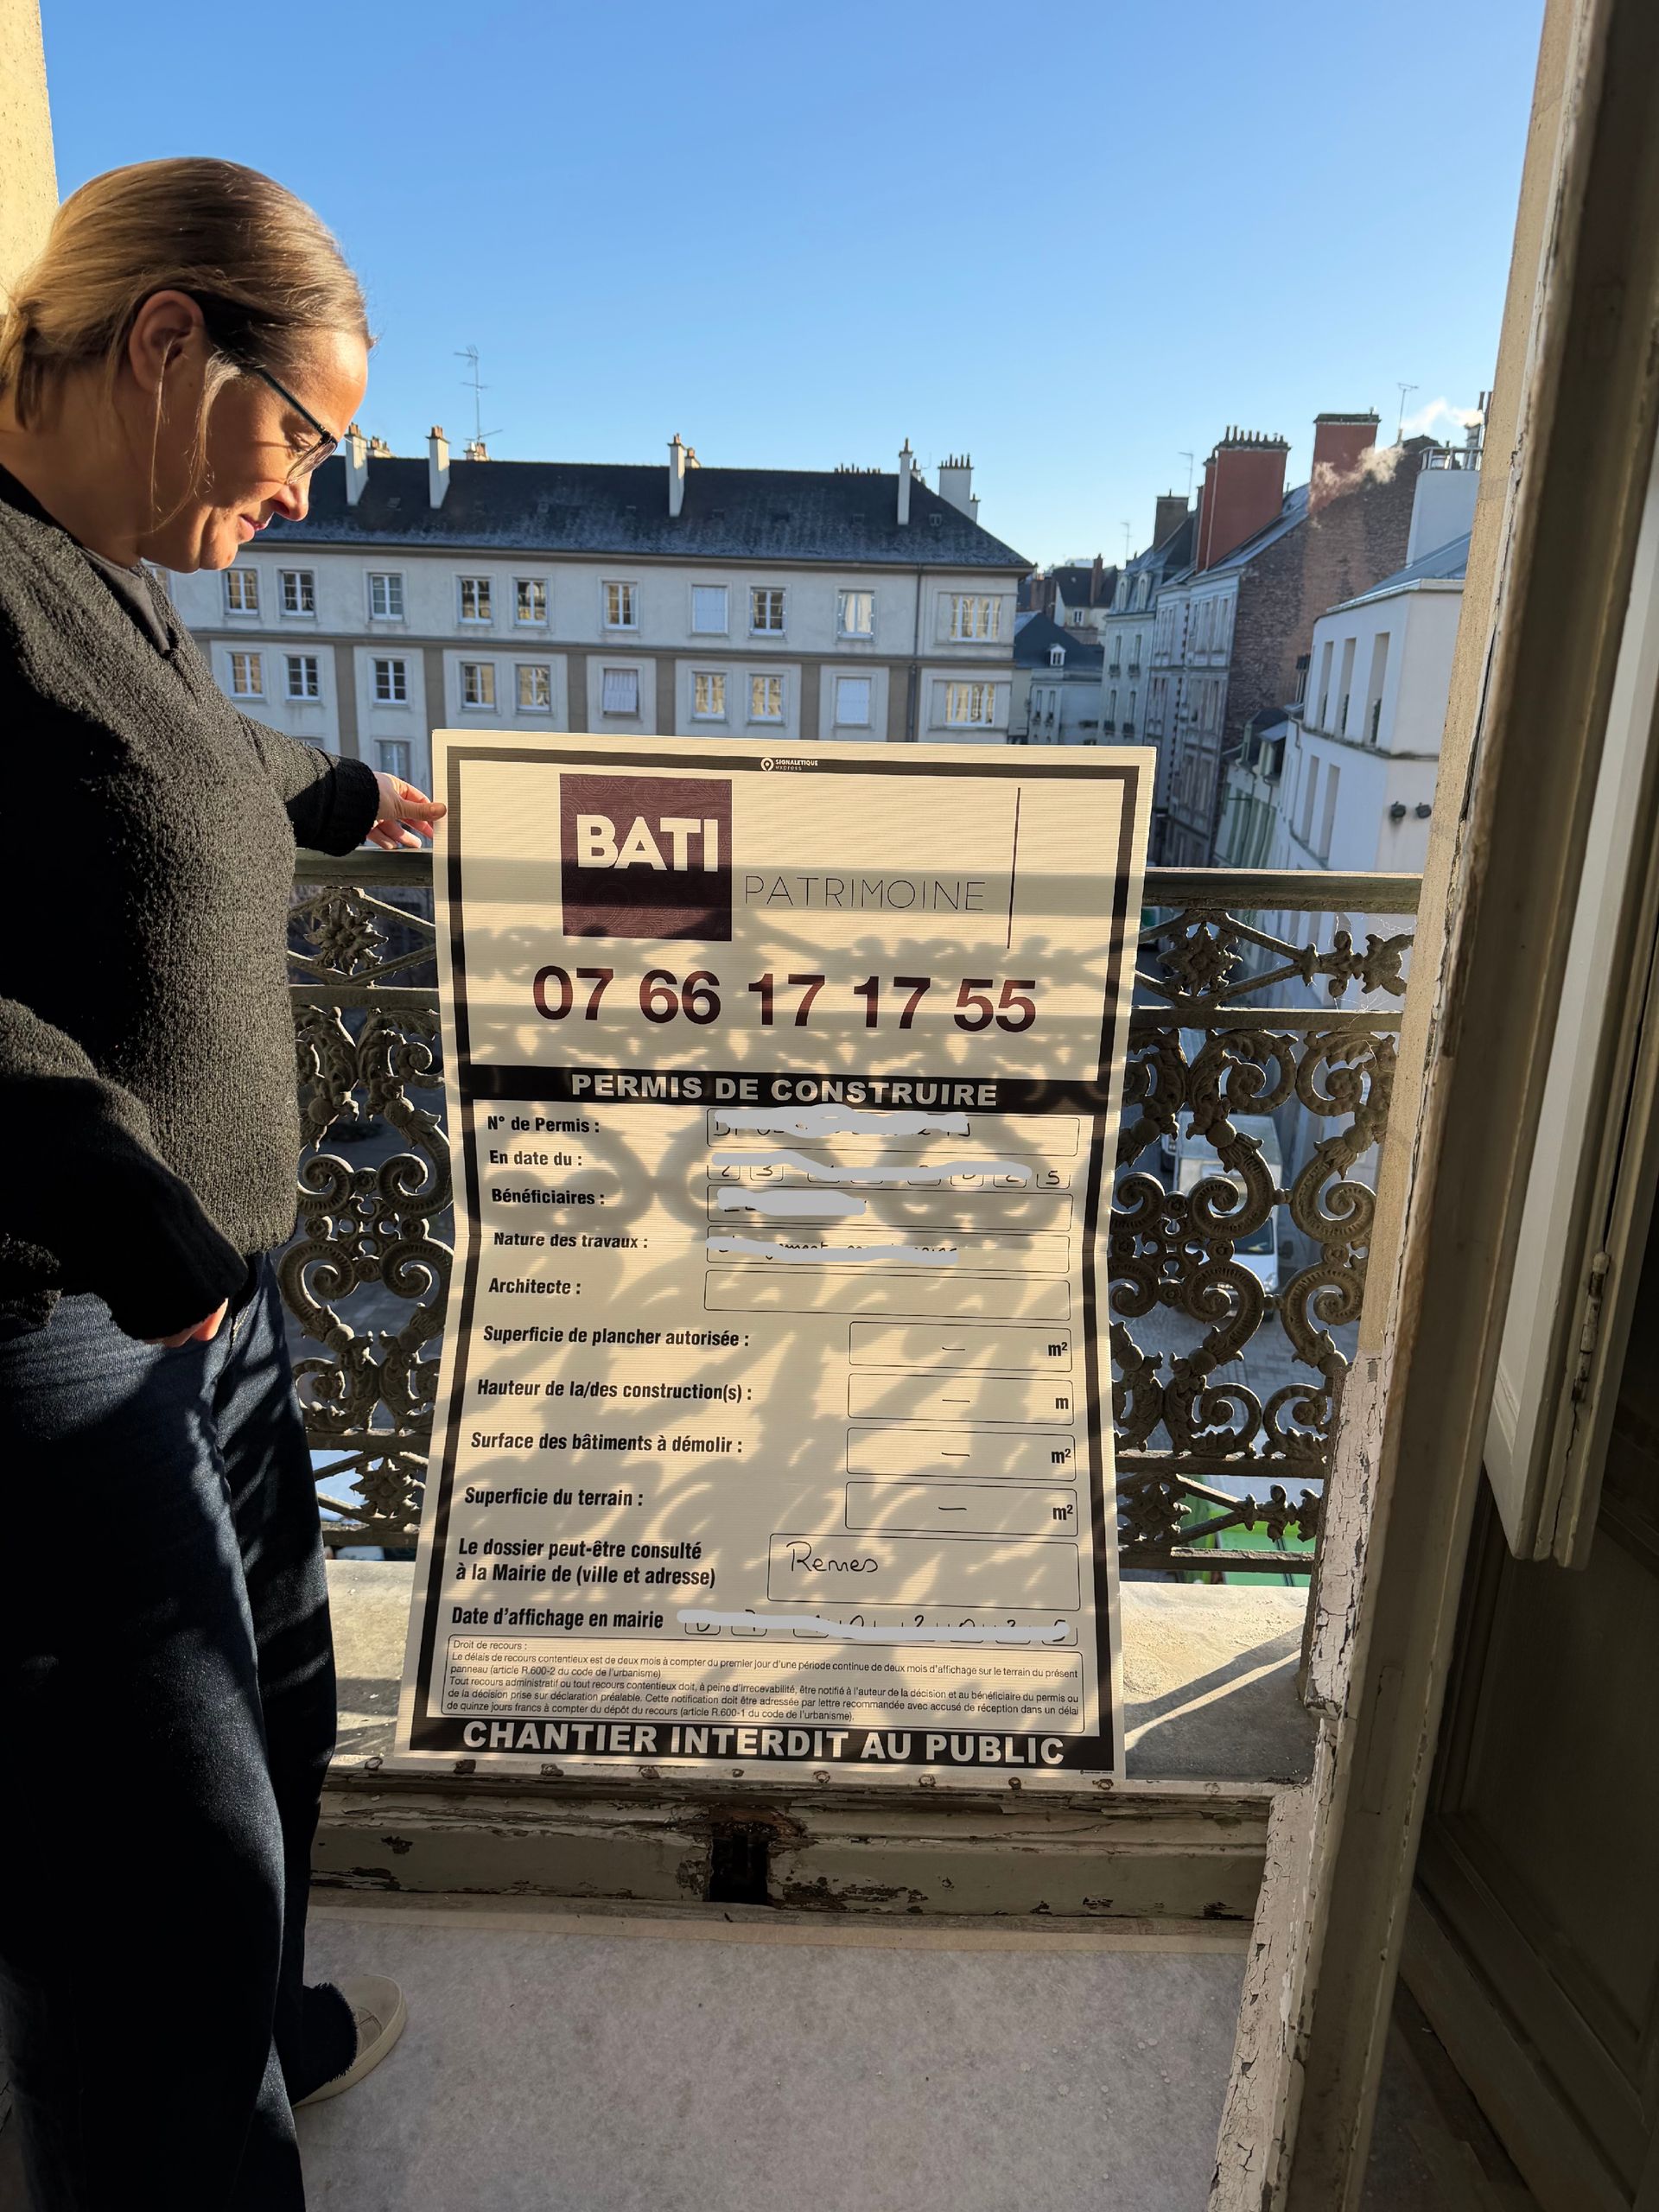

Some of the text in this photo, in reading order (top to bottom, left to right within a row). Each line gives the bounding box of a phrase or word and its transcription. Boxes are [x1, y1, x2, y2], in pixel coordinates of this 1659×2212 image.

[575, 815, 718, 873] BATI
[744, 874, 986, 912] PATRIMOINE
[532, 964, 1036, 1033] 07 66 17 17 55
[572, 1074, 995, 1105] PERMIS DE CONSTRUIRE
[487, 1115, 589, 1132] N° de Permis
[489, 1149, 571, 1166] En date du
[492, 1188, 594, 1205] Bénéficiaires
[493, 1230, 638, 1248] Nature des travaux
[488, 1277, 571, 1295] Architecte
[483, 1325, 739, 1345] Superficie de plancher autorisée
[477, 1379, 741, 1403] Hauteur de la/des construction(s)
[1055, 1396, 1069, 1409] m
[471, 1431, 732, 1452] Surface des bâtiments à démolir
[464, 1486, 632, 1506] Superficie du terrain
[458, 1537, 701, 1560] Le dossier peut-être consulté
[455, 1561, 715, 1589] à la Mairie de (ville et adresse)
[452, 1606, 488, 1624] Date
[493, 1607, 583, 1630] d'affichage
[588, 1612, 607, 1627] en
[613, 1610, 663, 1628] mairie
[453, 1640, 474, 1649] Droit
[476, 1641, 487, 1649] de
[450, 1665, 660, 1680] panneau (article R.600-2 du code de l'urbanisme)
[451, 1652, 462, 1661] Le
[464, 1652, 489, 1662] délais
[491, 1653, 502, 1662] de
[537, 1654, 588, 1664] contentieux
[589, 1656, 602, 1664] est
[604, 1656, 615, 1664] de
[617, 1656, 638, 1665] deux
[639, 1656, 660, 1666] mois
[669, 1657, 706, 1669] compter
[719, 1658, 753, 1669] premier
[753, 1661, 771, 1670] jour
[772, 1660, 796, 1669] d'une
[798, 1660, 830, 1672] période
[832, 1662, 868, 1671] continue
[870, 1662, 882, 1671] de
[883, 1662, 905, 1672] deux
[929, 1664, 976, 1676] d'affichage
[1002, 1667, 1030, 1676] terrain
[1032, 1668, 1043, 1677] du
[1045, 1669, 1077, 1680] présent
[448, 1688, 459, 1697] de
[471, 1688, 507, 1698] décision
[509, 1689, 531, 1700] prise
[550, 1690, 598, 1700] déclaration
[645, 1693, 669, 1702] Cette
[671, 1694, 718, 1703] notification
[721, 1694, 737, 1704] doit
[740, 1695, 757, 1704] être
[760, 1695, 798, 1705] adressée
[800, 1699, 816, 1707] par
[817, 1697, 840, 1707] lettre
[842, 1698, 904, 1708] recommandée
[930, 1700, 961, 1711] accusé
[963, 1702, 975, 1711] de
[977, 1702, 1018, 1714] réception
[1020, 1704, 1042, 1713] dans
[1058, 1706, 1078, 1715] délai
[449, 1676, 468, 1685] Tout
[505, 1677, 558, 1687] administratif
[573, 1679, 589, 1688] tout
[626, 1680, 676, 1690] contentieux
[706, 1682, 730, 1694] peine
[799, 1685, 816, 1694] être
[817, 1686, 844, 1695] notifié
[853, 1687, 886, 1696] l'auteur
[887, 1688, 899, 1697] de
[910, 1688, 945, 1699] décision
[971, 1690, 1020, 1701] bénéficiaire
[1036, 1693, 1065, 1705] permis
[446, 1700, 458, 1710] de
[460, 1700, 488, 1712] quinze
[490, 1704, 512, 1713] jours
[514, 1702, 541, 1712] francs
[551, 1703, 588, 1714] compter
[603, 1704, 629, 1715] dépôt
[631, 1705, 643, 1713] du
[680, 1706, 709, 1718] (article
[711, 1707, 745, 1717] R.600-1
[747, 1708, 760, 1717] du
[761, 1708, 784, 1718] code
[785, 1709, 797, 1719] de
[463, 1720, 1064, 1765] CHANTIER INTERDIT AU PUBLIC
